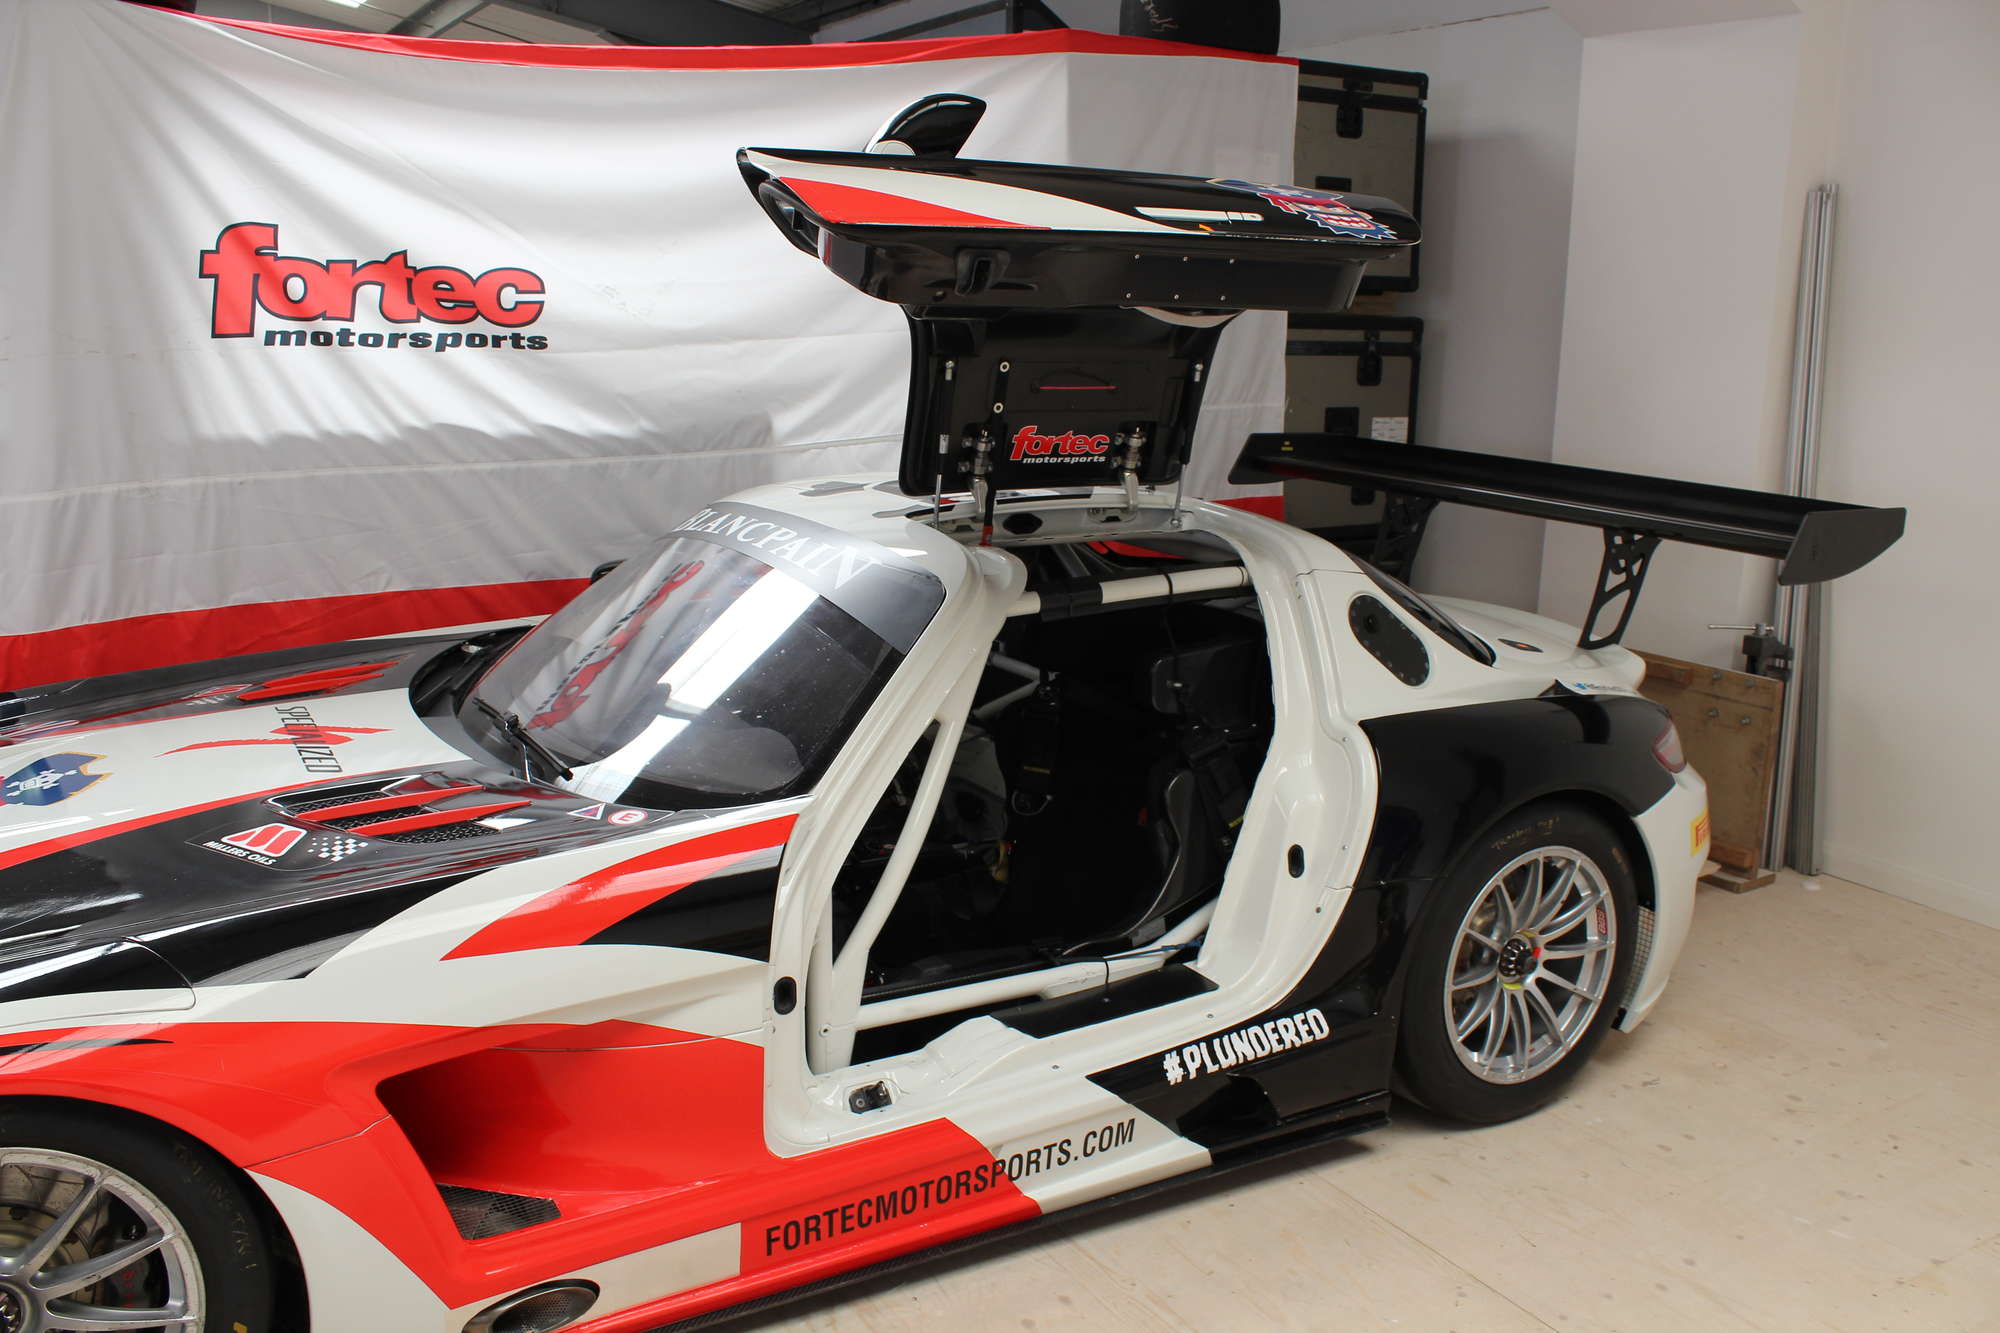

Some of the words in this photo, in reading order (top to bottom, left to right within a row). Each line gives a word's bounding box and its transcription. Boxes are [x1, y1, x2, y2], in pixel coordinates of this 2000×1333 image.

[199, 222, 545, 339] fortec
[263, 328, 549, 352] motorsports
[1010, 425, 1110, 461] fortec
[1023, 455, 1106, 464] motorsports
[672, 507, 883, 590] BLANCPAIN
[274, 705, 343, 773] SPECIALIZED
[202, 841, 250, 857] MILLERS
[247, 853, 277, 866] OILS
[1163, 1008, 1330, 1085] #PLUNDERED
[765, 1118, 1136, 1256] FORTECMOTORSPORTS.COM
